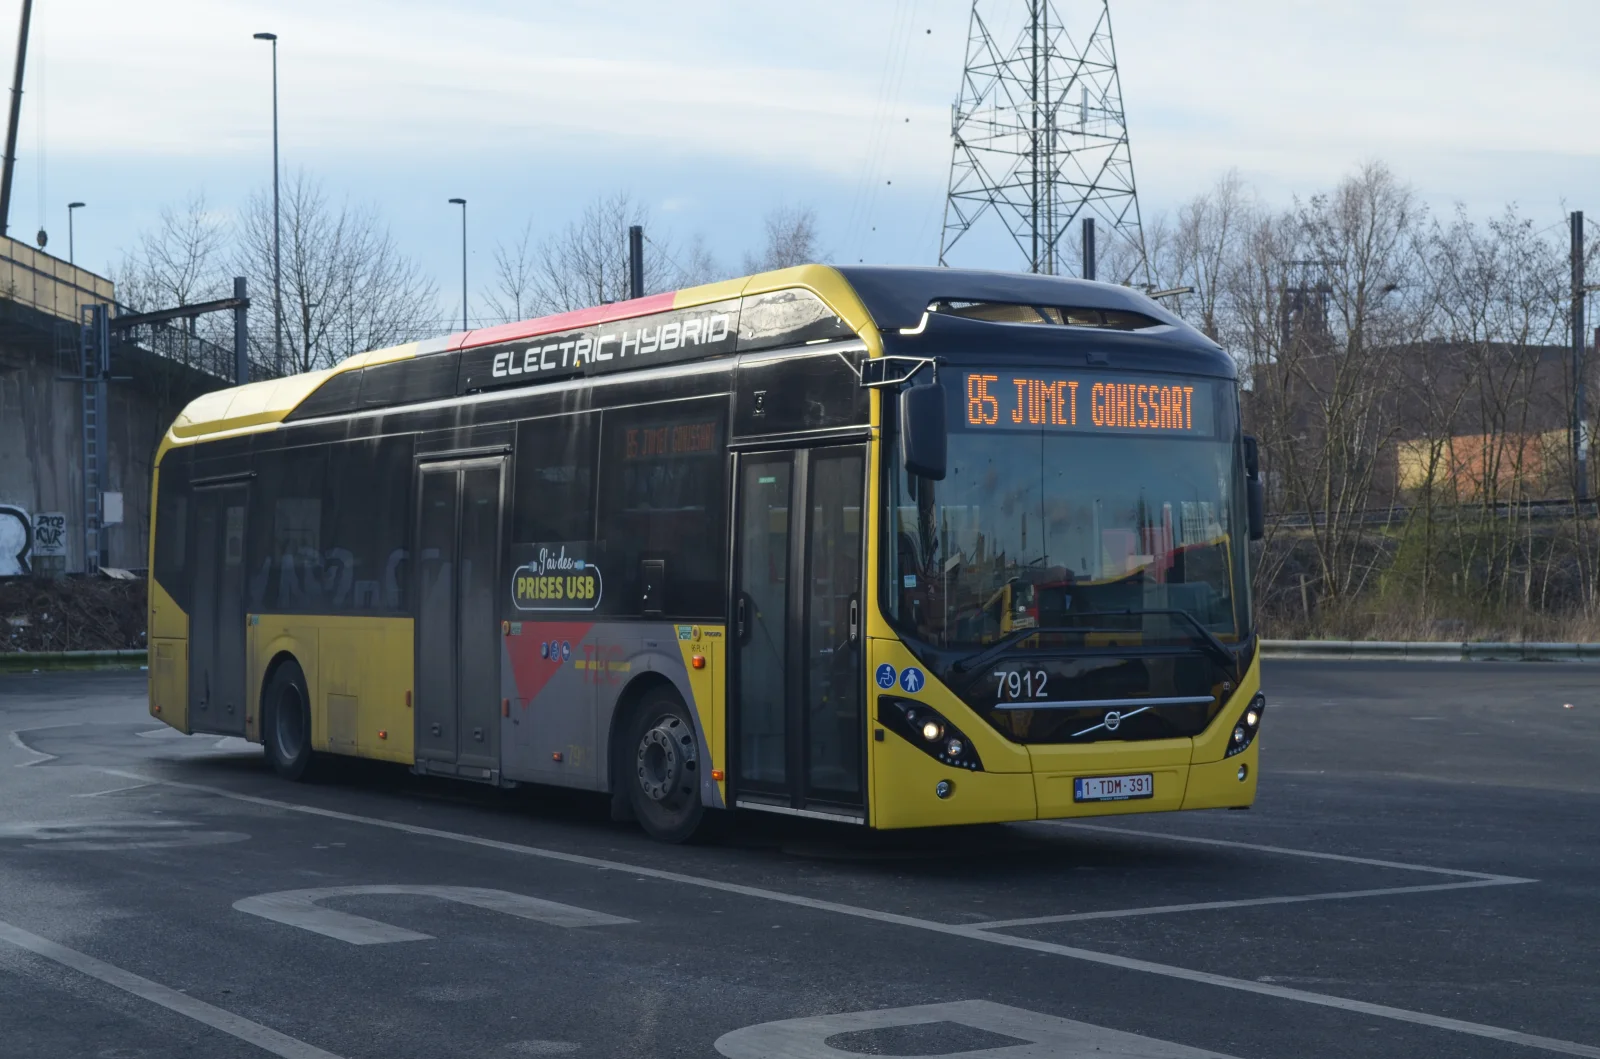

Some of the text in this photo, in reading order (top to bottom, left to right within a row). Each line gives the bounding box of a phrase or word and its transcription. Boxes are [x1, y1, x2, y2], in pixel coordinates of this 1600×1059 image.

[491, 313, 730, 378] ELECTRIC HYBRID
[967, 374, 1194, 429] 85 JUMET GOHISSART
[538, 545, 574, 576] J'ai des
[517, 575, 595, 600] PRISES USB
[582, 644, 624, 687] TEC
[993, 670, 1048, 699] 7912
